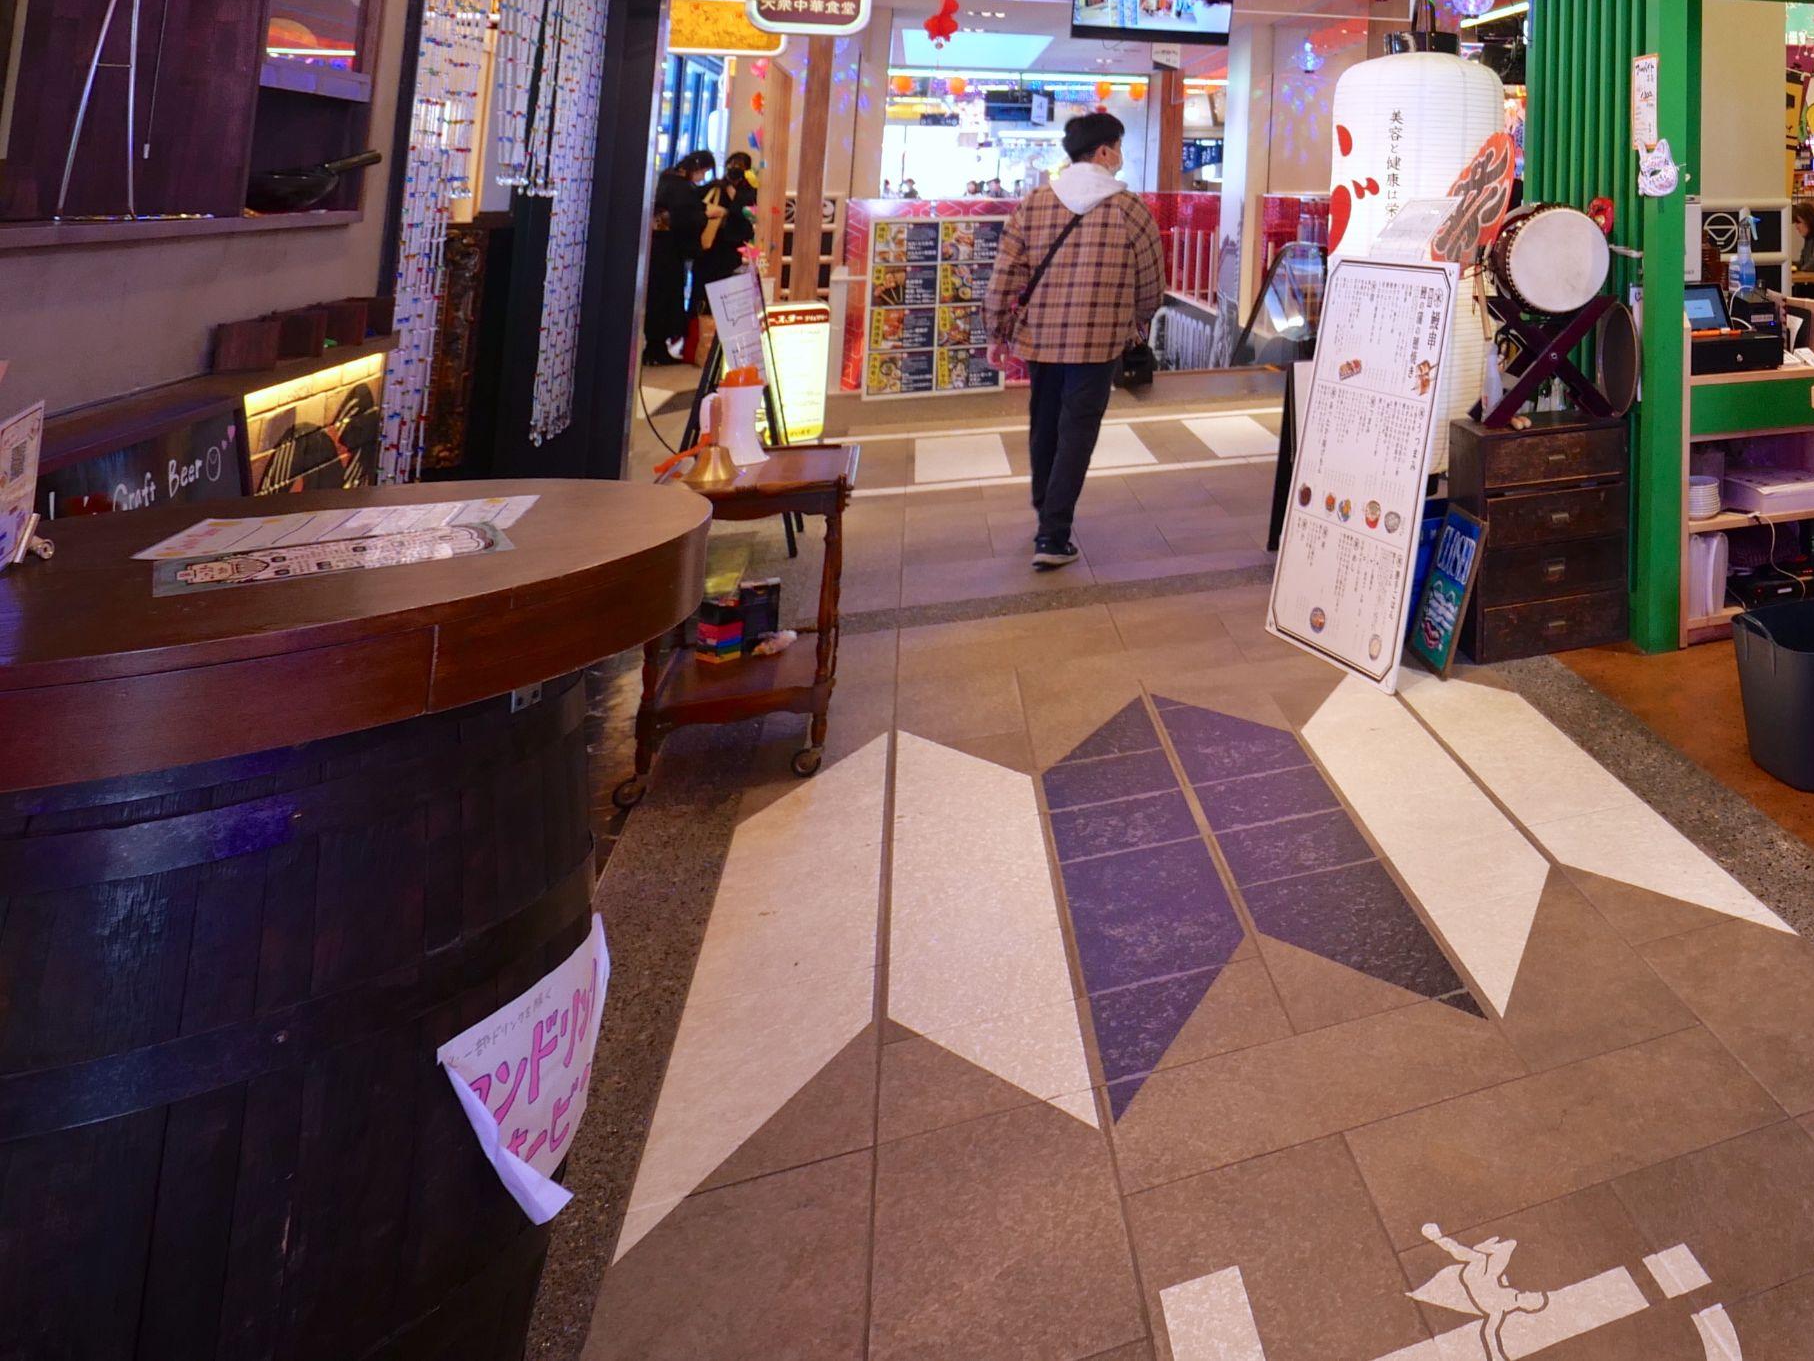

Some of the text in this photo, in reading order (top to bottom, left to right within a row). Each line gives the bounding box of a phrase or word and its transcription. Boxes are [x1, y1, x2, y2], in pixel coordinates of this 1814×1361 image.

[1384, 109, 1406, 221] 美容と健康は栄
[112, 471, 156, 512] Craft
[168, 459, 203, 499] Beer
